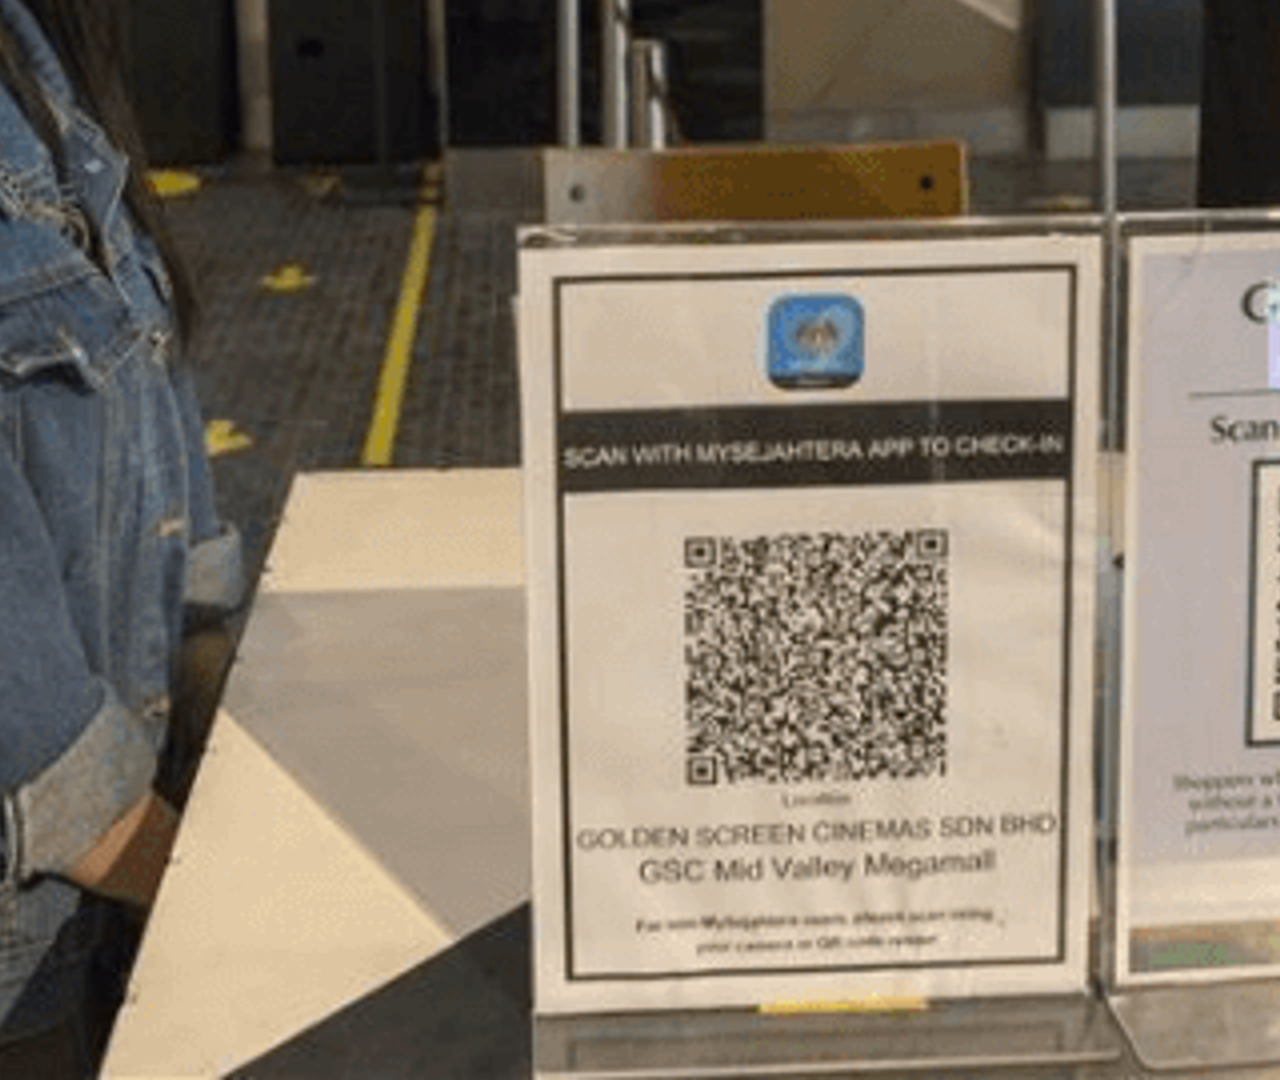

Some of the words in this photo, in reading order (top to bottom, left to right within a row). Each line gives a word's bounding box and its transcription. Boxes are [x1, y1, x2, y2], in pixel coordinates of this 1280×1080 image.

[1211, 417, 1280, 444] Scan
[563, 445, 627, 469] SCAN
[631, 442, 691, 466] WITH
[696, 438, 863, 464] MYSEJAHTERA
[868, 437, 914, 460] APP
[919, 434, 951, 458] TO
[955, 431, 1065, 456] CHECK-IN
[576, 826, 690, 850] GOLDEN
[696, 822, 806, 848] SCREEN
[812, 817, 934, 844] CINEMAS
[939, 815, 995, 839] SDN
[1000, 811, 1057, 835] BHD
[639, 858, 706, 886] GSC
[713, 856, 763, 882] Mid
[771, 853, 854, 885] Valley
[864, 847, 997, 881] Megamall
